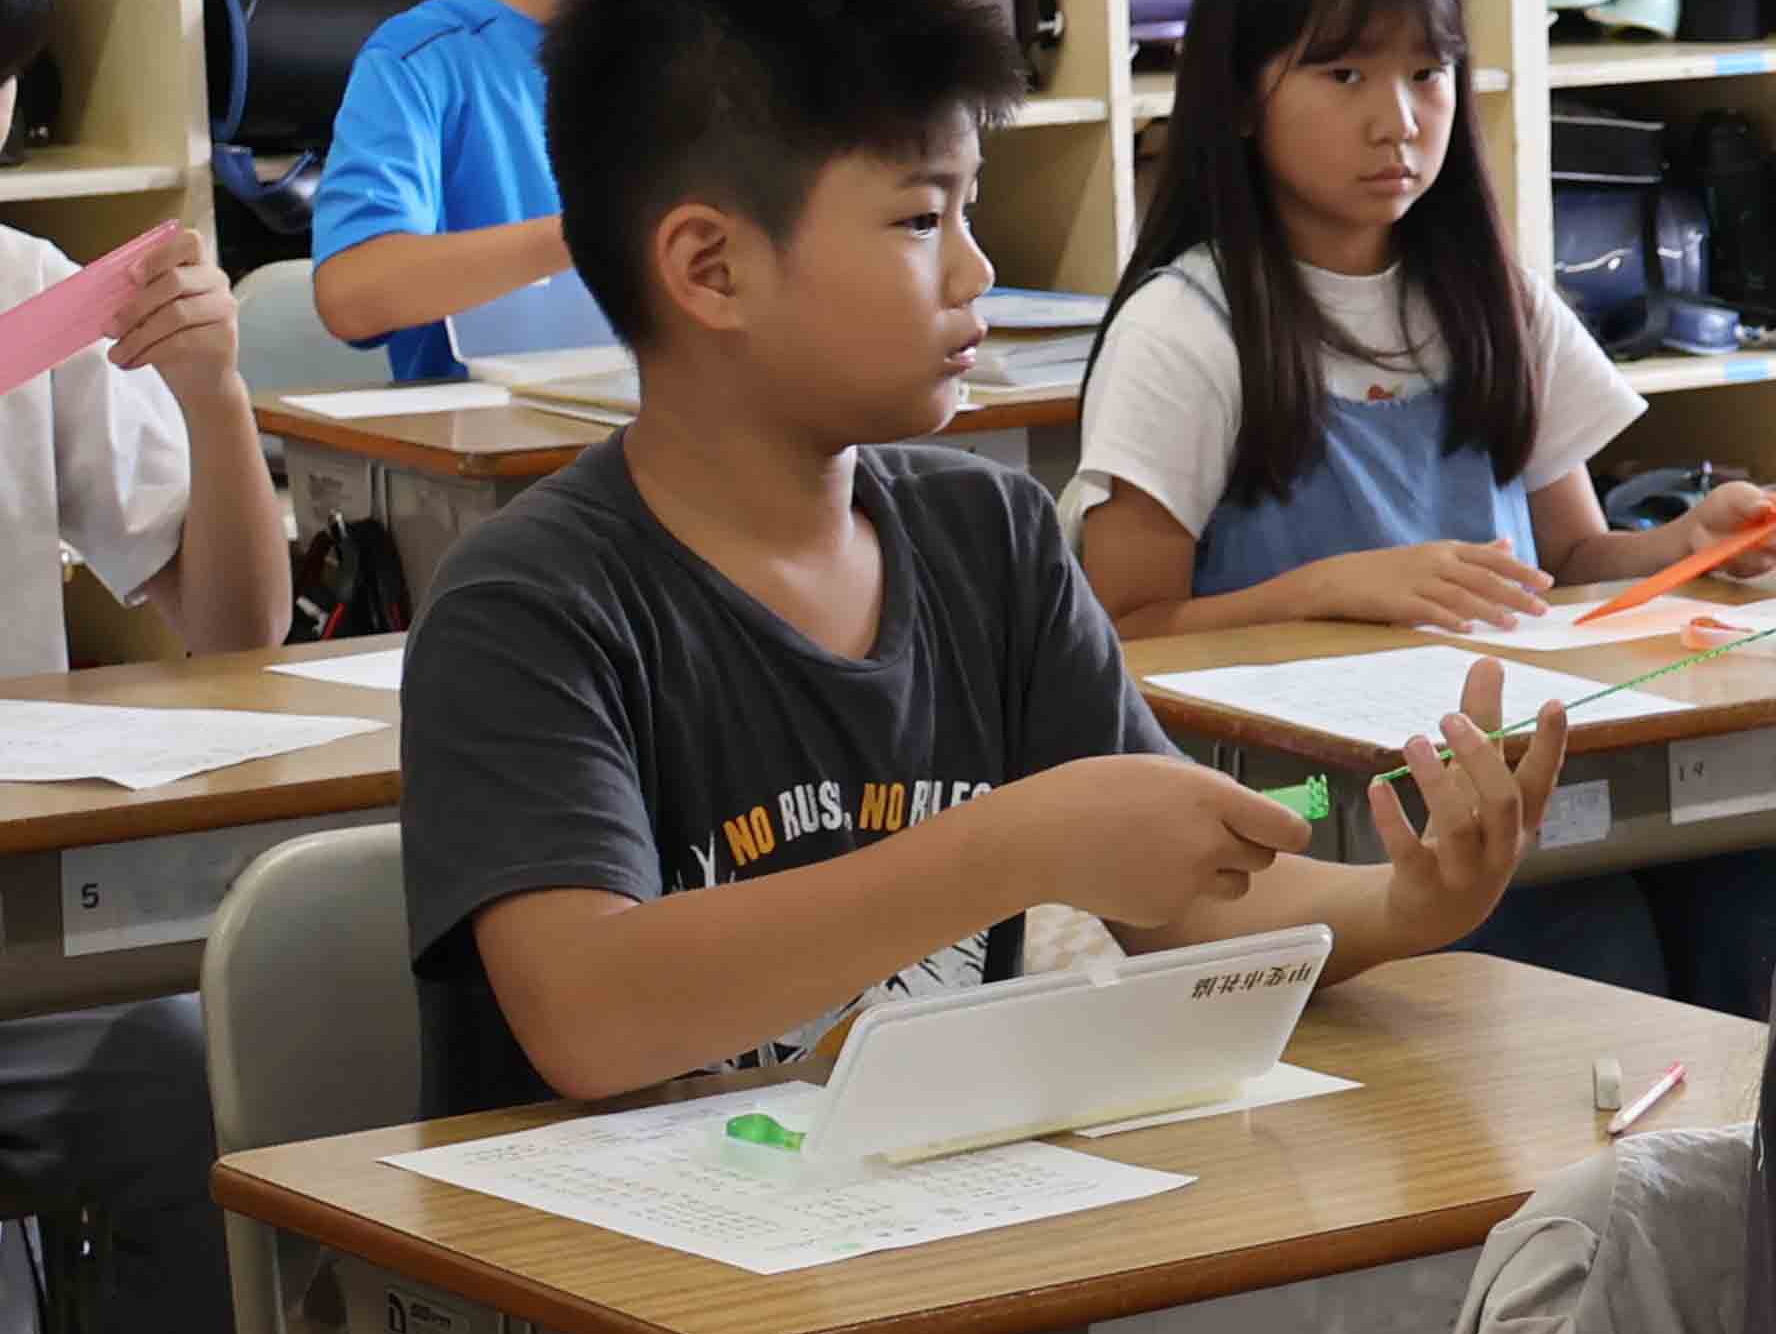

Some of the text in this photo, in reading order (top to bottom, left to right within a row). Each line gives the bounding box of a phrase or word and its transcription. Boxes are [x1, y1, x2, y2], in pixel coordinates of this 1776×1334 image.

[722, 804, 777, 867] NO
[778, 779, 854, 844] RUS,
[858, 781, 905, 833] NO
[80, 882, 99, 910] 5
